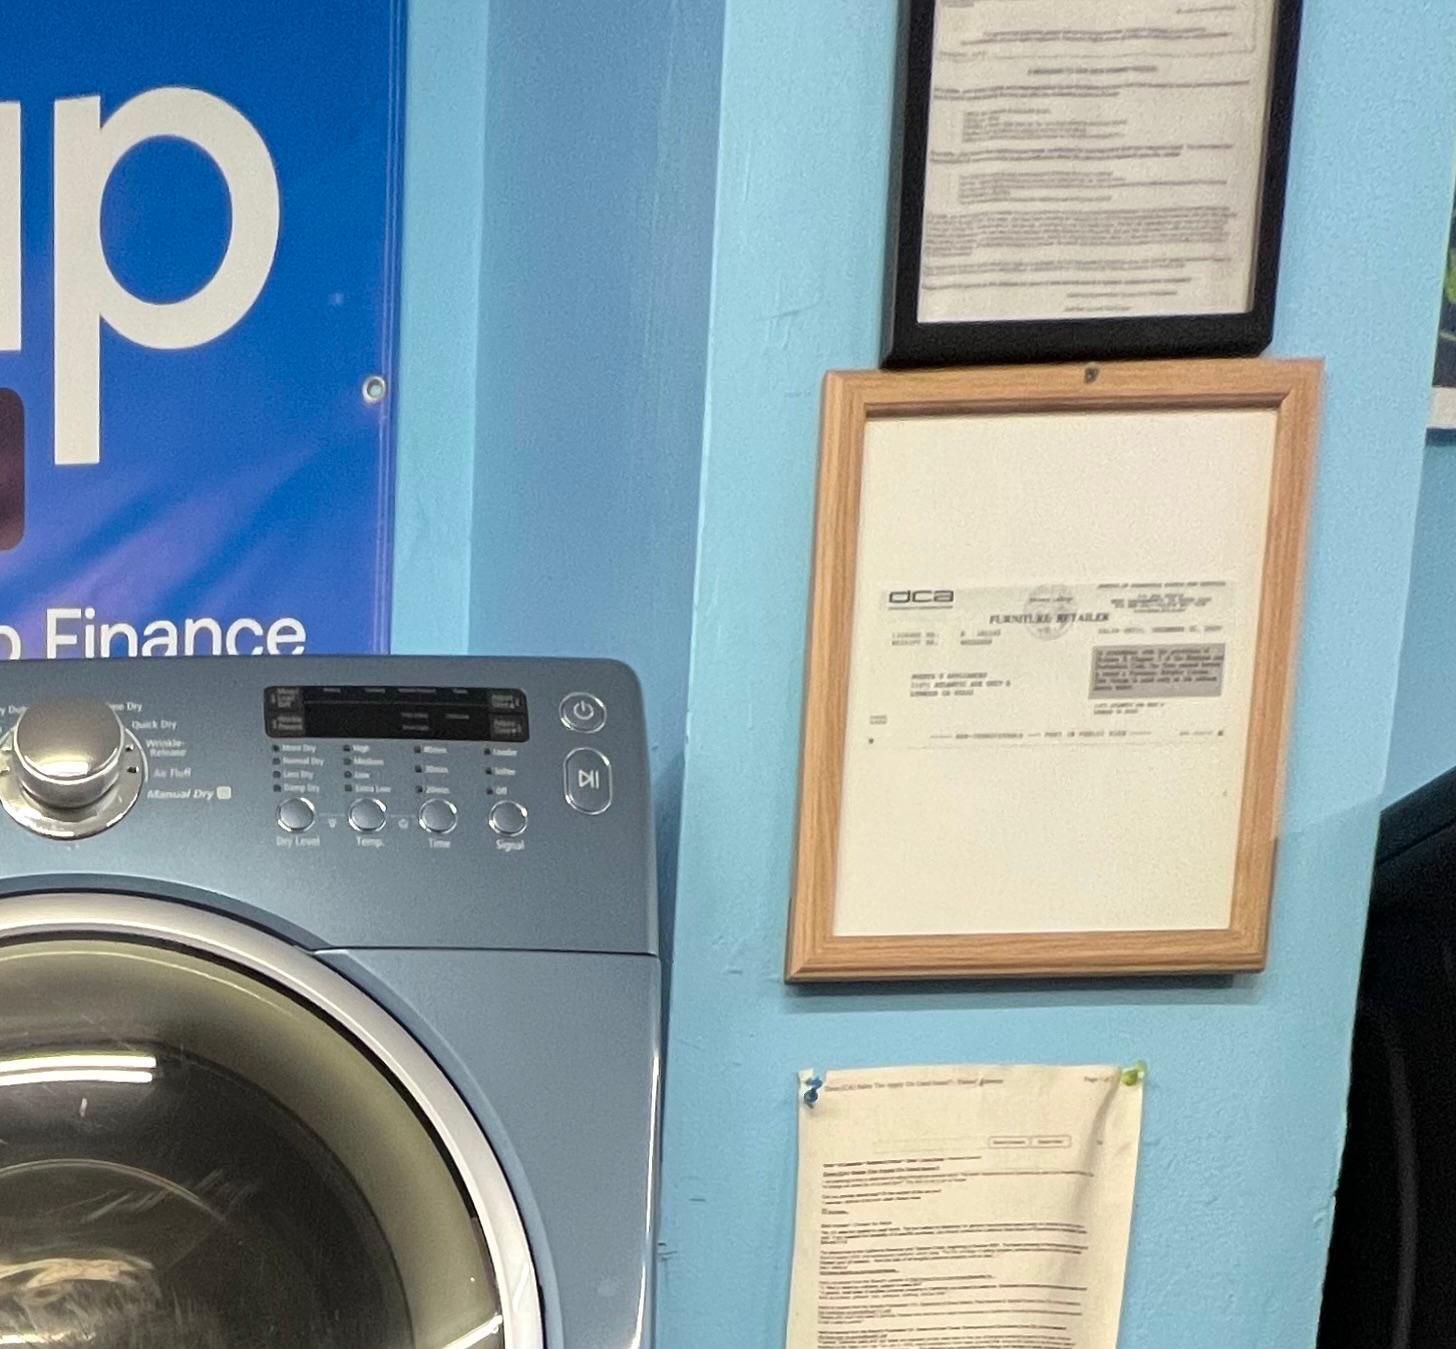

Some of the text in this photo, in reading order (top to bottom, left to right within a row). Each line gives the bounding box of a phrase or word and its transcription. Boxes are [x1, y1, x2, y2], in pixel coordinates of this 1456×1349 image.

[46, 607, 307, 660] Finance
[126, 702, 143, 713] Dry
[161, 720, 177, 730] Dry
[147, 789, 215, 801] Manual Dry
